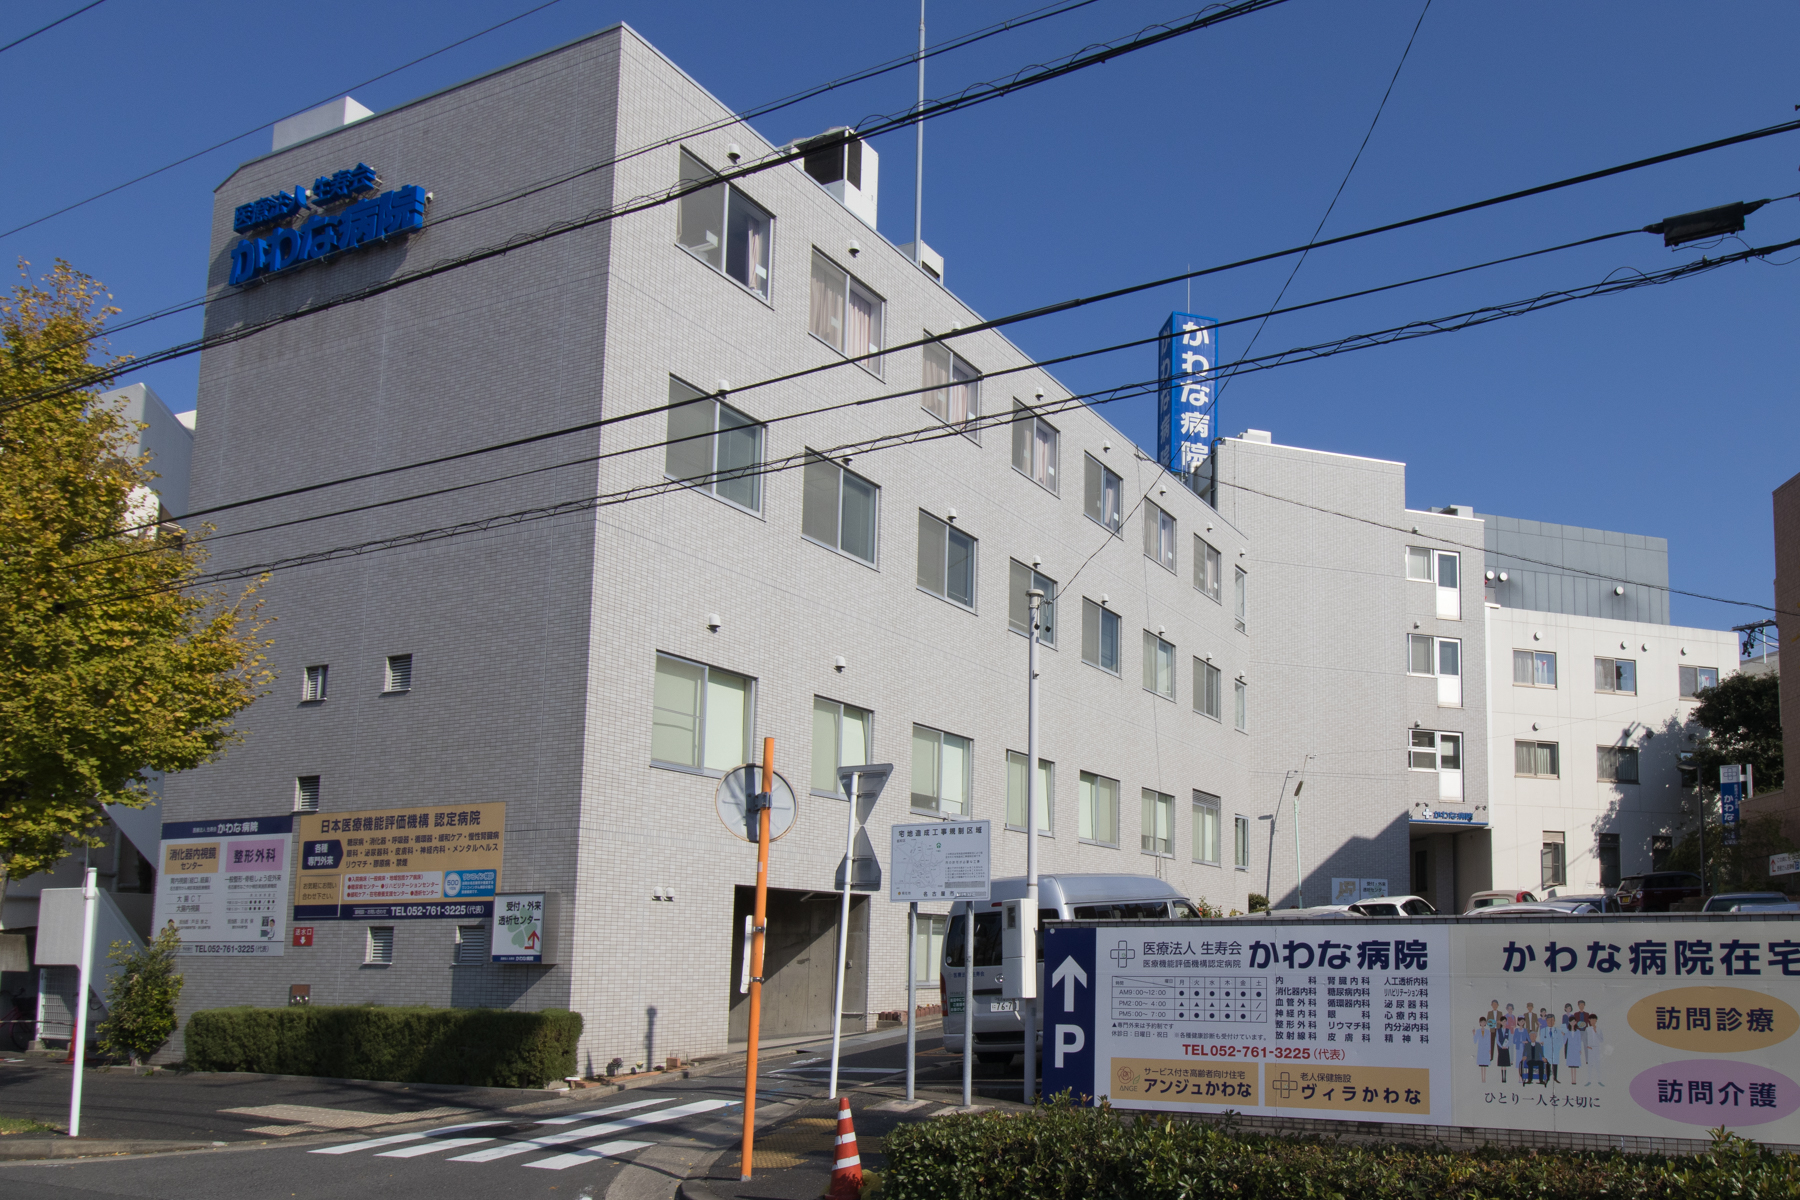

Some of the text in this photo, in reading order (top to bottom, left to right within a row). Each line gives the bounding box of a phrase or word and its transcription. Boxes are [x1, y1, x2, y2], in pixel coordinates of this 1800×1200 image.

[233, 162, 377, 235] 医療法人 生寿会
[229, 184, 425, 286] かわな病院
[1180, 321, 1210, 466] かわな病院
[1433, 811, 1473, 820] かわな病院
[217, 821, 258, 834] かわな病院
[321, 810, 481, 834] 日本医療機能評価機構 認定病院
[899, 826, 982, 838] 宅地造成工事規制区域
[314, 843, 328, 853] 各種
[169, 847, 217, 861] 消化器内視鏡
[233, 848, 276, 864] 整形外科
[180, 862, 203, 871] センター
[307, 856, 334, 867] 専門外来
[384, 882, 440, 890] リハビリテーションセンター
[302, 892, 334, 900] 合わせ下さい。
[506, 901, 542, 912] 受付・外来
[498, 915, 541, 926] 透析センター
[1143, 939, 1428, 971] 医療法人 生寿会 かわな病院
[1502, 939, 1800, 976] かわな病院在宅
[1143, 959, 1242, 969] 医療機能評価機構認定病院
[1327, 976, 1370, 986] 腎臓内科
[1384, 976, 1428, 986] 人工透析内科
[1275, 987, 1317, 996] 消化器内科
[1327, 988, 1370, 997] 糖尿病内科
[1384, 988, 1428, 998] リハビリテーション科
[1275, 998, 1317, 1008] 血管外科
[1327, 999, 1370, 1008] 循環器内科
[1384, 999, 1429, 1009] 泌尿器科
[1275, 1009, 1317, 1019] 神経内科
[1384, 1011, 1429, 1021] 心療内科
[1655, 1006, 1775, 1033] 訪問診療
[1275, 1020, 1317, 1030] 整形外科
[1328, 1021, 1371, 1031] リウマチ科
[1384, 1022, 1429, 1033] 内分泌内科
[1275, 1031, 1317, 1041] 放射線科
[1327, 1033, 1371, 1043] 皮膚科
[1384, 1034, 1429, 1044] 精神科
[1054, 1023, 1085, 1068] P
[1144, 1067, 1246, 1080] サービス付き高齢者向け住宅
[1300, 1072, 1352, 1084] 老人保健施設
[1144, 1078, 1252, 1098] アンジュかわな
[1657, 1079, 1777, 1108] 訪問介護
[1301, 1083, 1421, 1105] ヴィラかわな
[1484, 1092, 1601, 1108] ひとり一人を大切に
